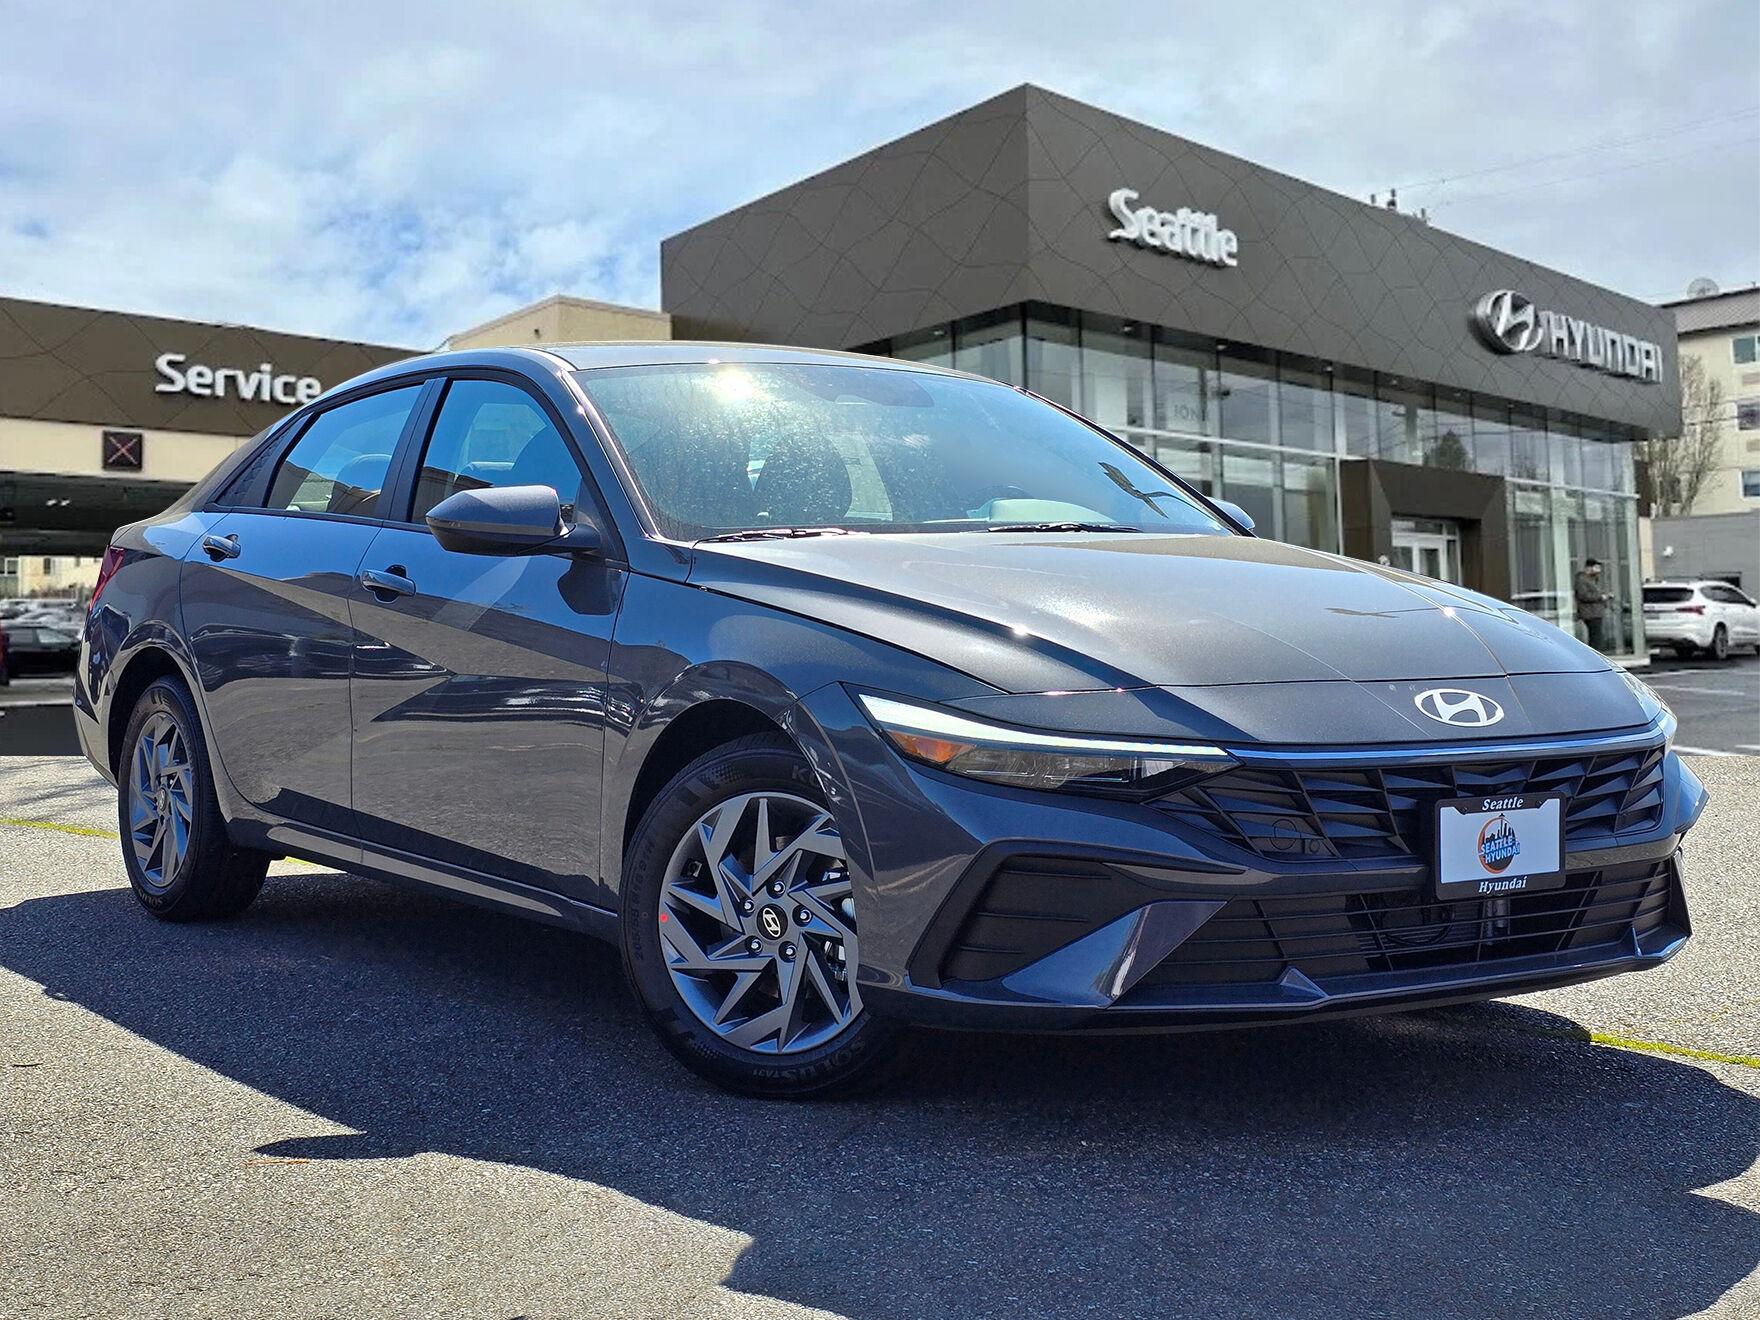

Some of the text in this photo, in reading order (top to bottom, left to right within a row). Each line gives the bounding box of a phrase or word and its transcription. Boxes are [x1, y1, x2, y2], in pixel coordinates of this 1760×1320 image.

[1108, 187, 1238, 267] Seattle
[1541, 311, 1663, 382] HYUNDAI
[155, 353, 322, 404] Service
[1482, 797, 1524, 811] Seattle
[1481, 836, 1513, 855] SEATTLE
[1484, 842, 1520, 864] HYUNDAI
[1478, 876, 1528, 894] Hyundai
